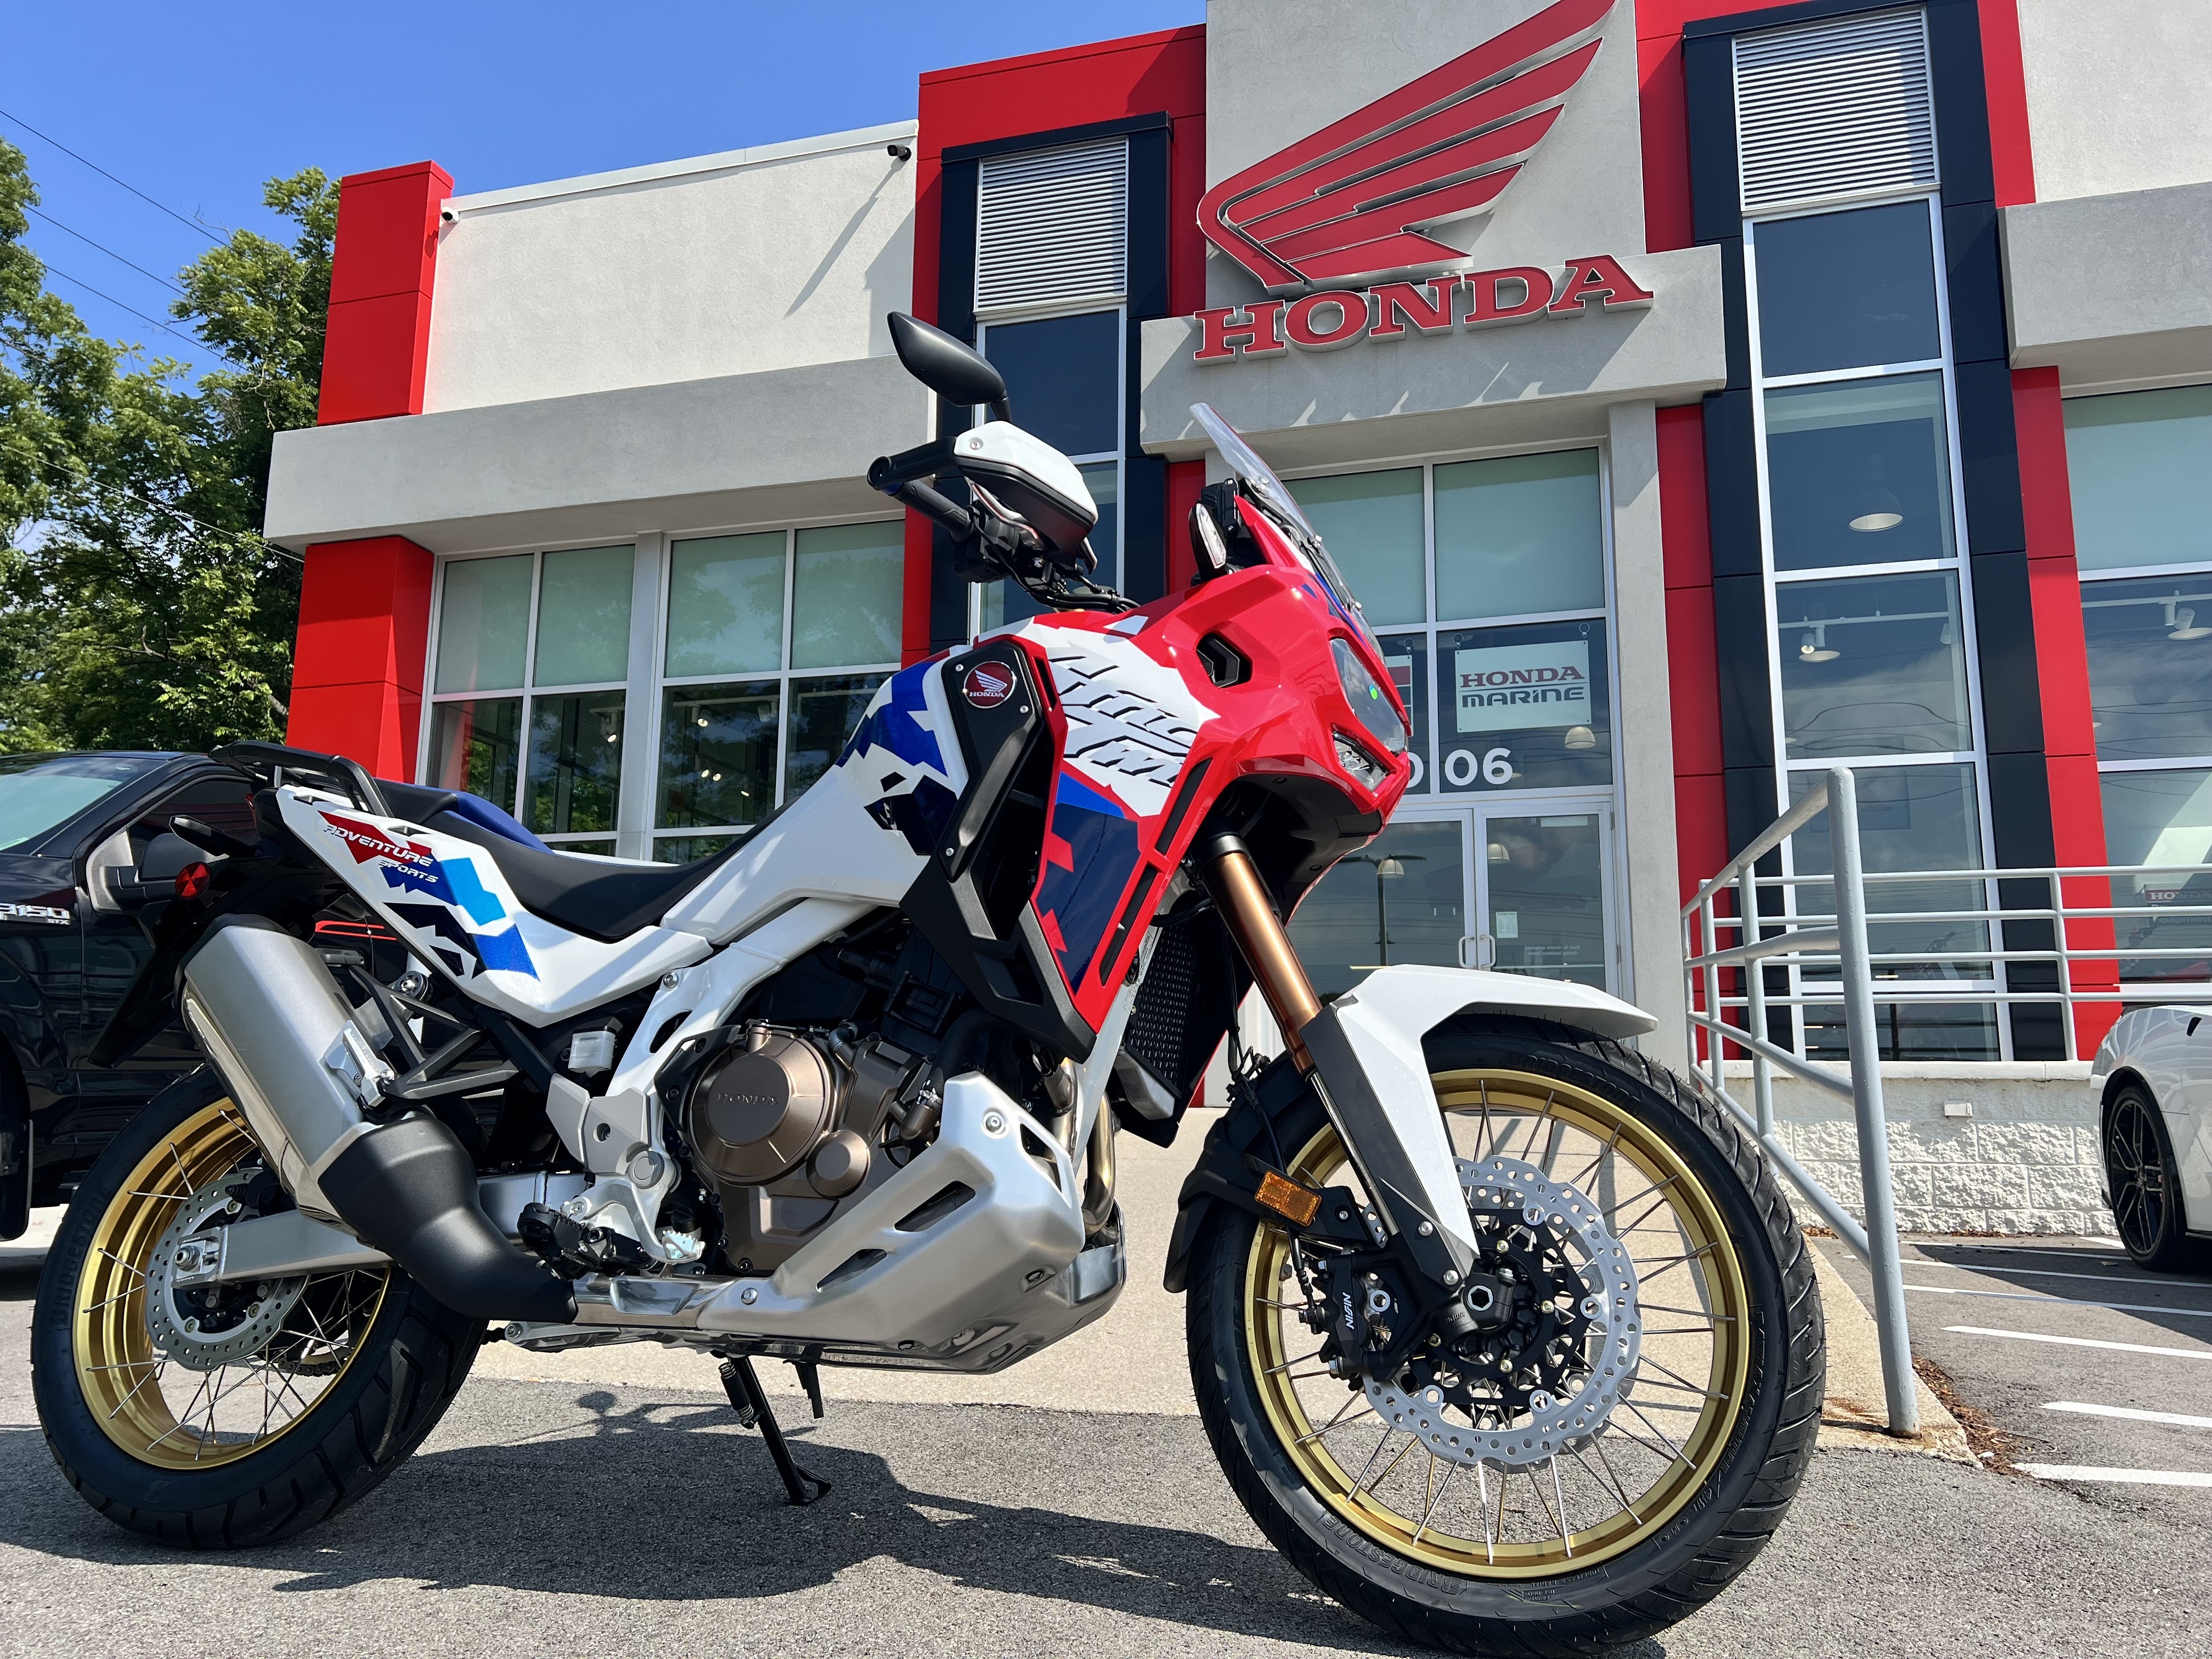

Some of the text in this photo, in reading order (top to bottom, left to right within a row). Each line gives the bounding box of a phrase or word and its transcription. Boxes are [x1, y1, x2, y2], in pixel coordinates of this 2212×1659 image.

[1193, 254, 1654, 366] HONDA
[1460, 666, 1585, 688] HONDA
[1462, 686, 1585, 708] MARINE
[323, 825, 433, 867] ADVENTURE
[378, 859, 438, 883] SPORTS
[1504, 1051, 1643, 1110] BRIDGESTONE
[716, 1092, 780, 1105] HONDA
[1249, 1342, 1257, 1365] JAPAN
[1323, 1516, 1464, 1595] BRIDGESTONE
